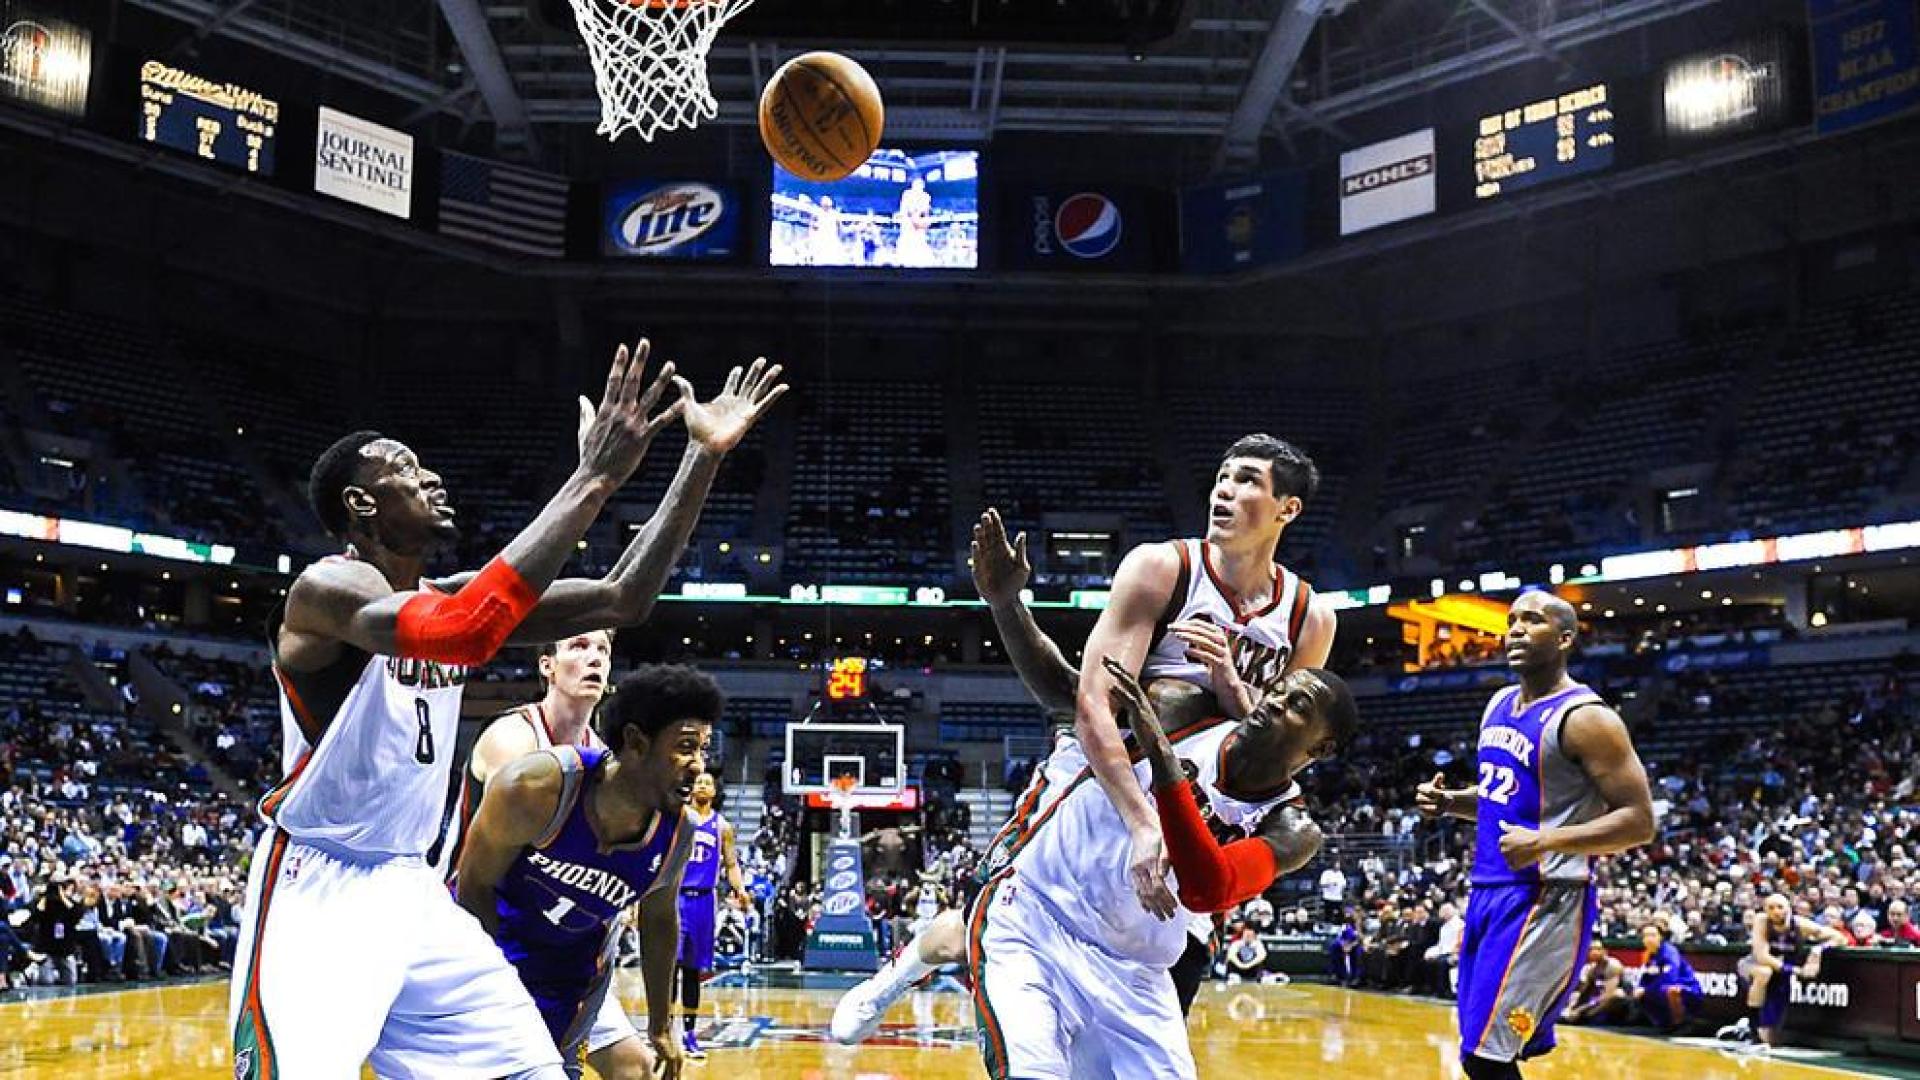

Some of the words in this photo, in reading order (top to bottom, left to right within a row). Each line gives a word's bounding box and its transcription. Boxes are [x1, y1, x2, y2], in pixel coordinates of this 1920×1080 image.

[319, 150, 409, 193] SENTINEL
[322, 130, 410, 174] JOURNAL
[1346, 159, 1429, 193] KOHL'S
[633, 200, 716, 249] Lite
[1033, 195, 1052, 254] pepsi
[829, 672, 861, 698] 24
[415, 697, 435, 764] 8
[1479, 726, 1535, 767] PHOENIX
[1478, 761, 1514, 805] 22
[527, 851, 637, 909] PHOENIX
[542, 896, 576, 925] 1
[1694, 972, 1738, 997] UCKS
